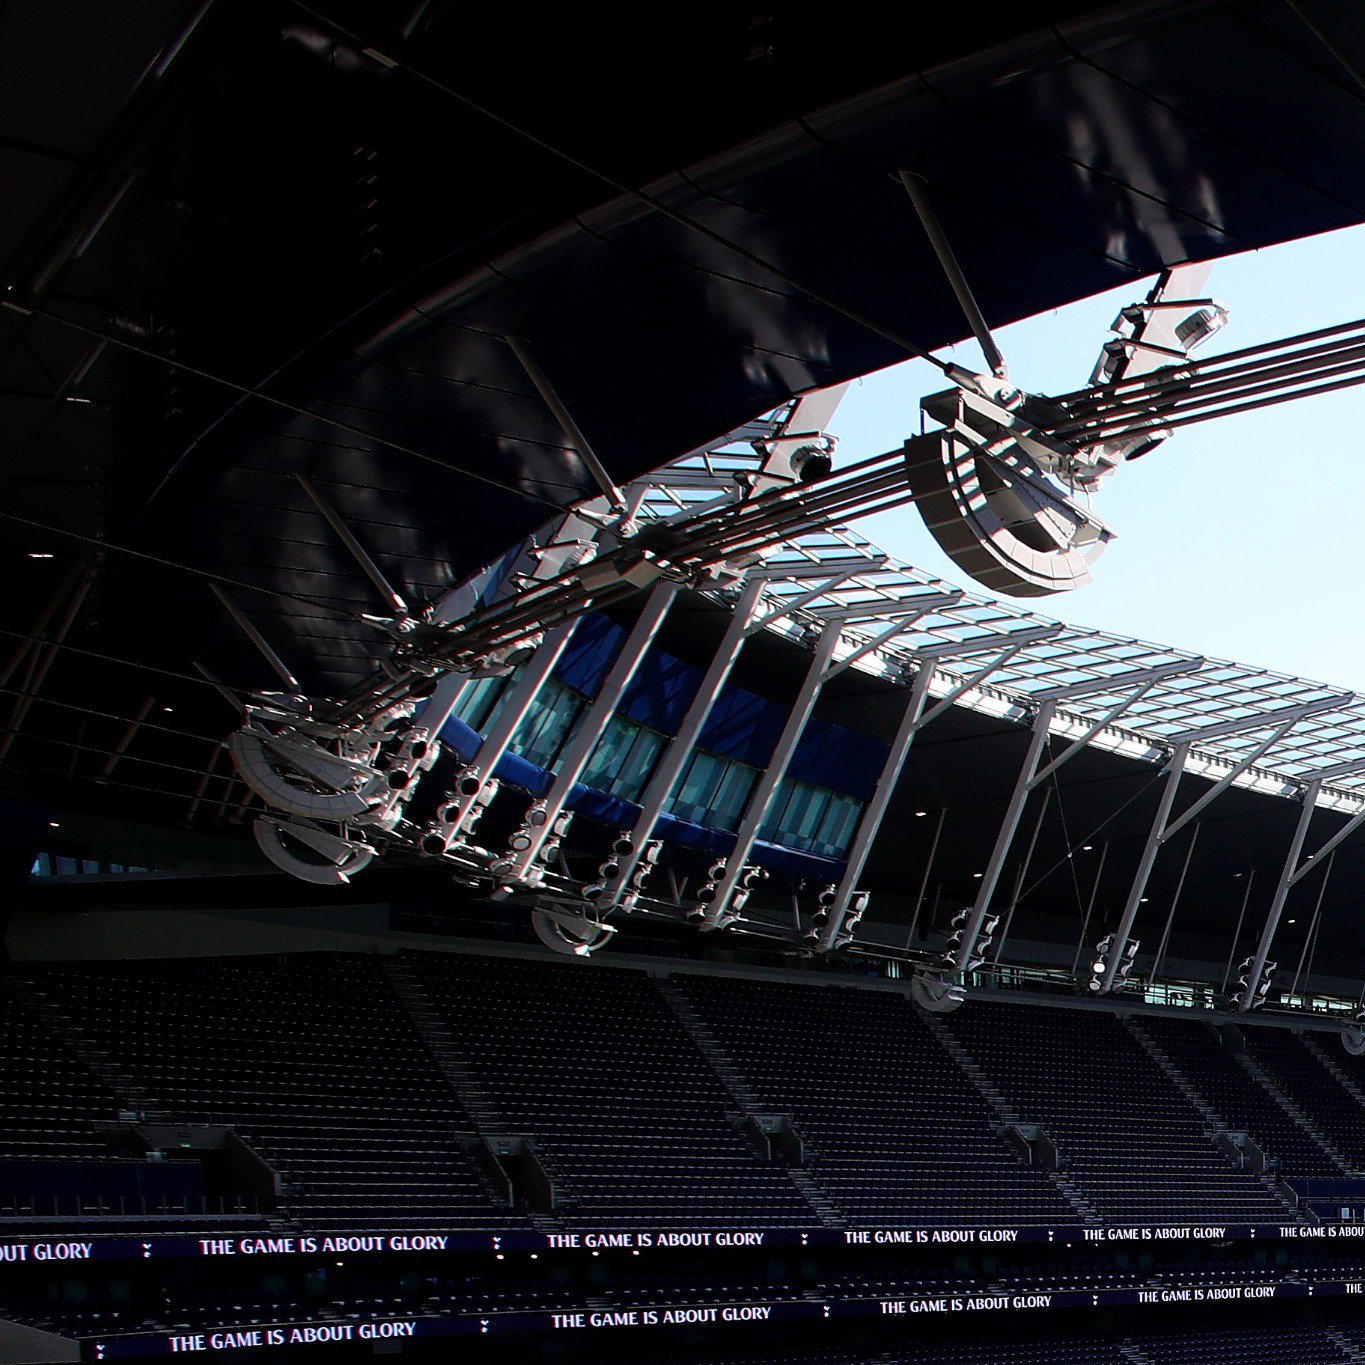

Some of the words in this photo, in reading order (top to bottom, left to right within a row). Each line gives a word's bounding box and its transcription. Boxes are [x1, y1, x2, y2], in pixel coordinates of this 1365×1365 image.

[547, 1235, 580, 1247] THE
[585, 1234, 632, 1247] GAME
[638, 1234, 652, 1246] IS
[657, 1233, 711, 1246] ABOUT
[716, 1233, 763, 1245] GLORY
[844, 1232, 871, 1243] THE
[875, 1231, 912, 1243] GAME
[917, 1231, 928, 1242] IS
[932, 1231, 975, 1242] ABOUT
[979, 1230, 1018, 1241] GLORY
[1083, 1229, 1105, 1240] THE
[1108, 1229, 1139, 1240] GAME
[1142, 1229, 1151, 1239] IS
[1155, 1228, 1190, 1239] ABOUT
[1193, 1228, 1225, 1238] GLORY
[0, 1245, 29, 1261] UT
[33, 1243, 92, 1260] GLORY
[199, 1240, 235, 1254] THE
[240, 1239, 295, 1254] GAME
[300, 1238, 317, 1252] IS
[323, 1237, 385, 1251] ABOUT
[390, 1236, 448, 1250] GLORY
[1138, 1290, 1160, 1302] THE
[1162, 1289, 1191, 1301] GAME
[1195, 1290, 1204, 1300] IS
[1207, 1288, 1241, 1299] ABOUT
[1244, 1287, 1275, 1297] GLORY
[880, 1302, 906, 1313] THE
[910, 1300, 947, 1312] GAME
[952, 1299, 963, 1310] IS
[967, 1297, 1009, 1310] ABOUT
[1013, 1296, 1051, 1308] GLORY
[551, 1314, 585, 1328] THE
[590, 1312, 638, 1326] GAME
[644, 1311, 658, 1324] IS
[663, 1309, 717, 1323] ABOUT
[722, 1307, 771, 1320] GLORY
[169, 1335, 206, 1351] THE
[211, 1331, 262, 1349] GAME
[267, 1330, 284, 1344] IS
[291, 1326, 353, 1343] ABOUT
[359, 1322, 415, 1338] GLORY
